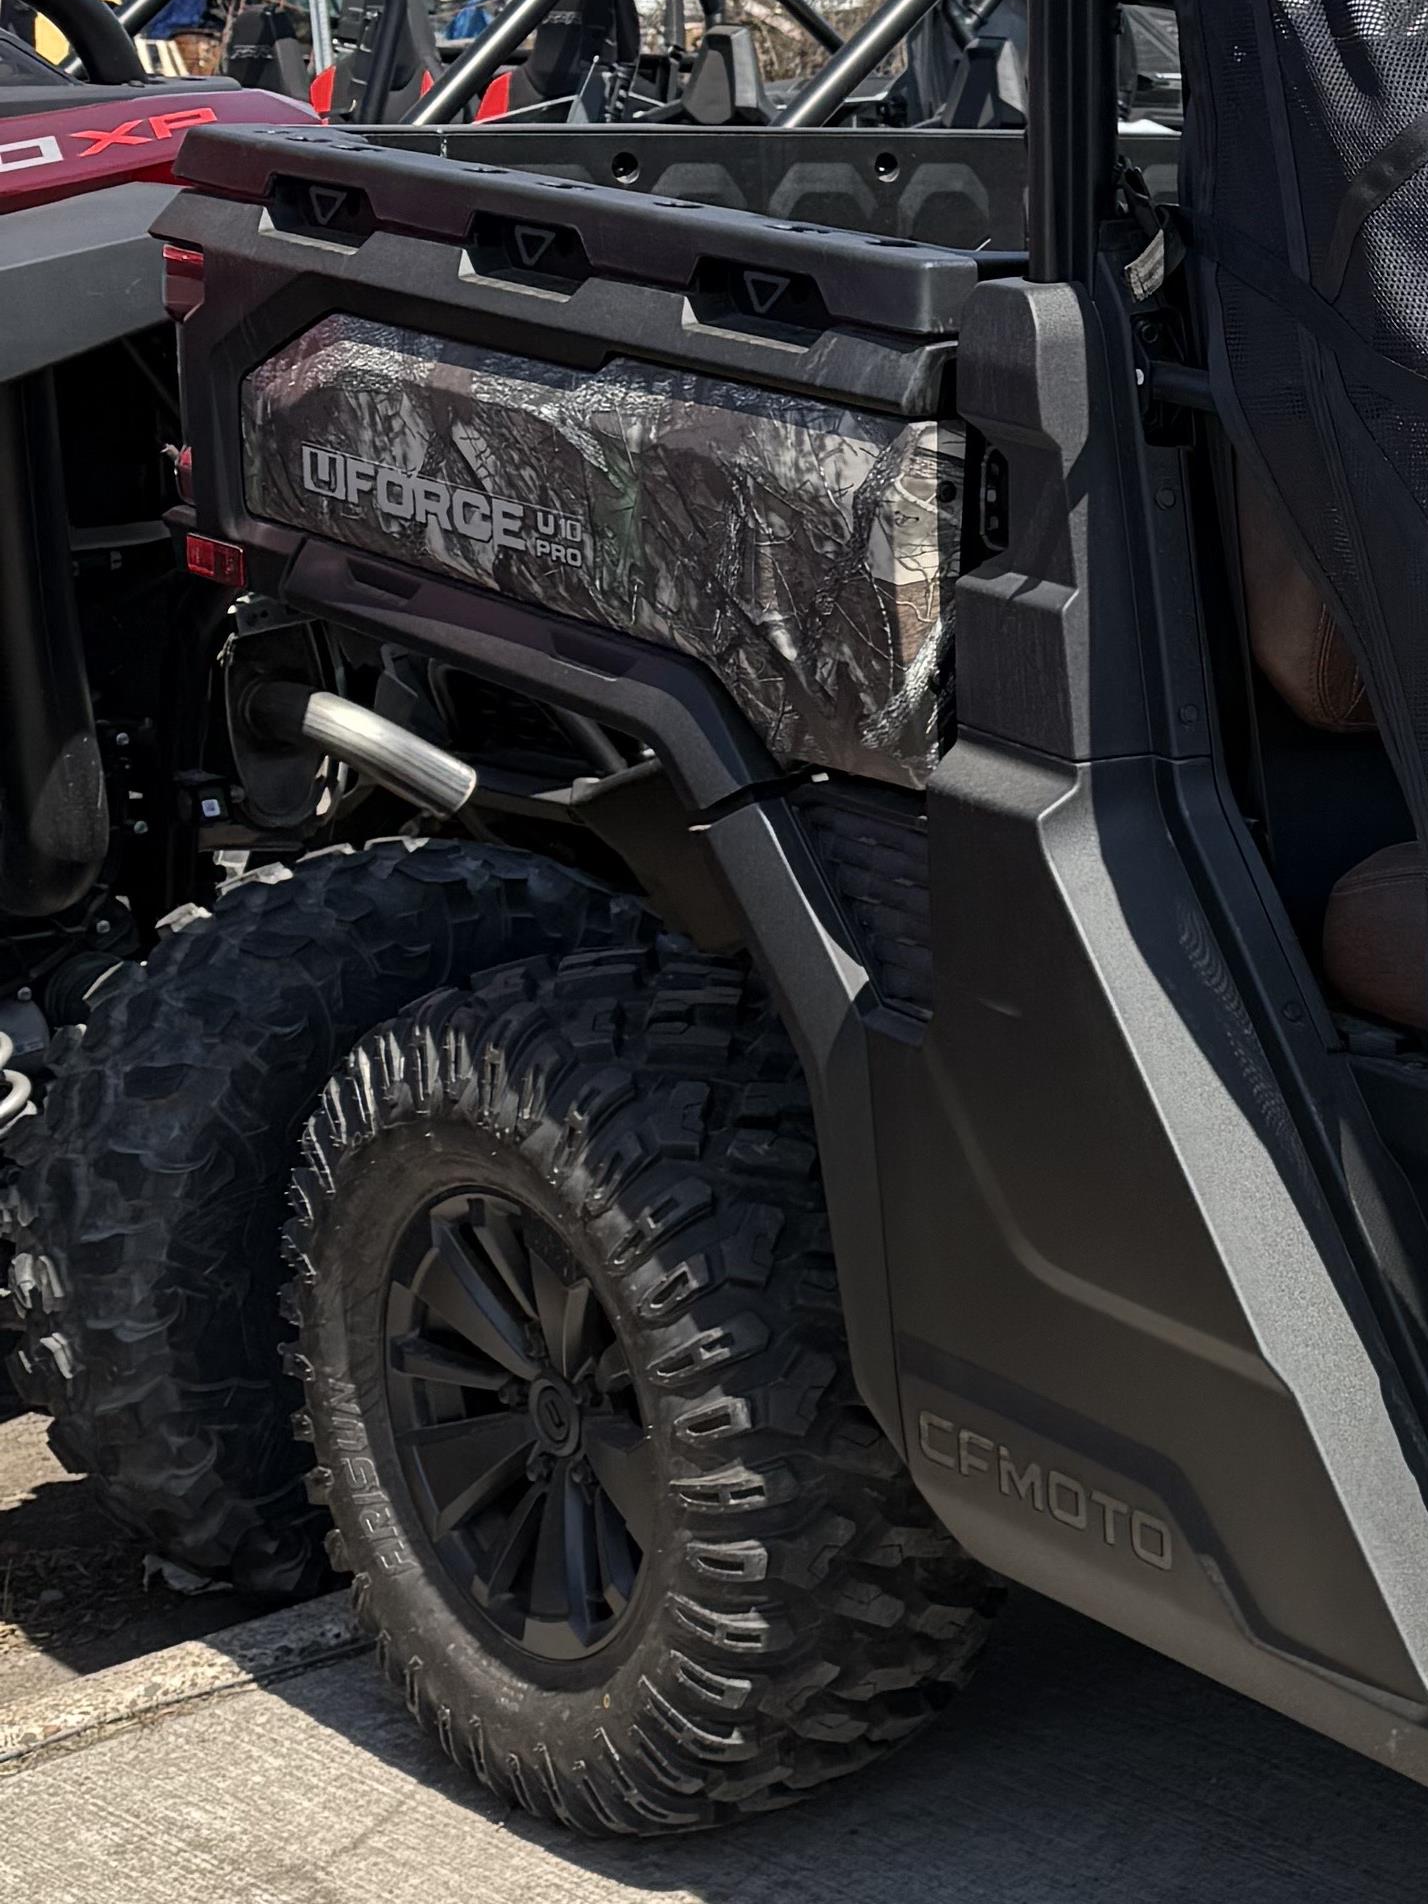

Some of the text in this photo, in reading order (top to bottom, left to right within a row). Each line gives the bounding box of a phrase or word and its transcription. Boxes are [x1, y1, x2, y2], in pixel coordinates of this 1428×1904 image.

[69, 107, 218, 157] XP
[302, 444, 526, 551] UFORCE
[536, 540, 583, 567] PRO
[919, 1410, 1173, 1571] CFMOTO
